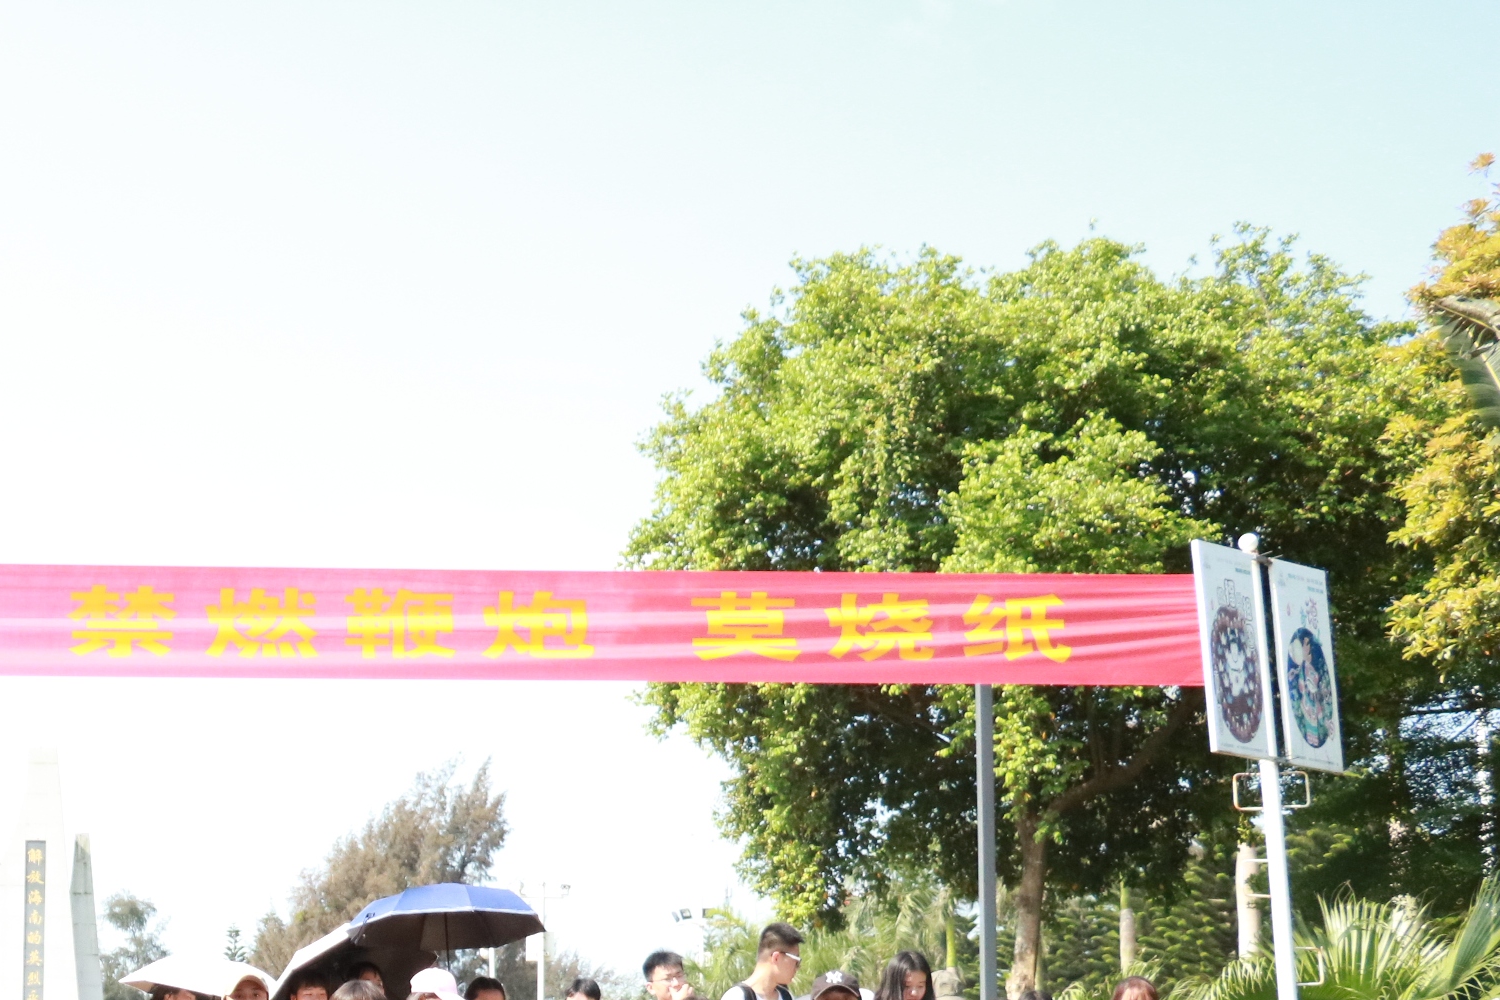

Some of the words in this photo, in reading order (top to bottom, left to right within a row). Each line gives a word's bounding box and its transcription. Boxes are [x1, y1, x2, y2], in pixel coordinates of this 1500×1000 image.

[67, 584, 597, 659] 禁燃鞭炮
[691, 590, 1073, 663] 莫烧纸
